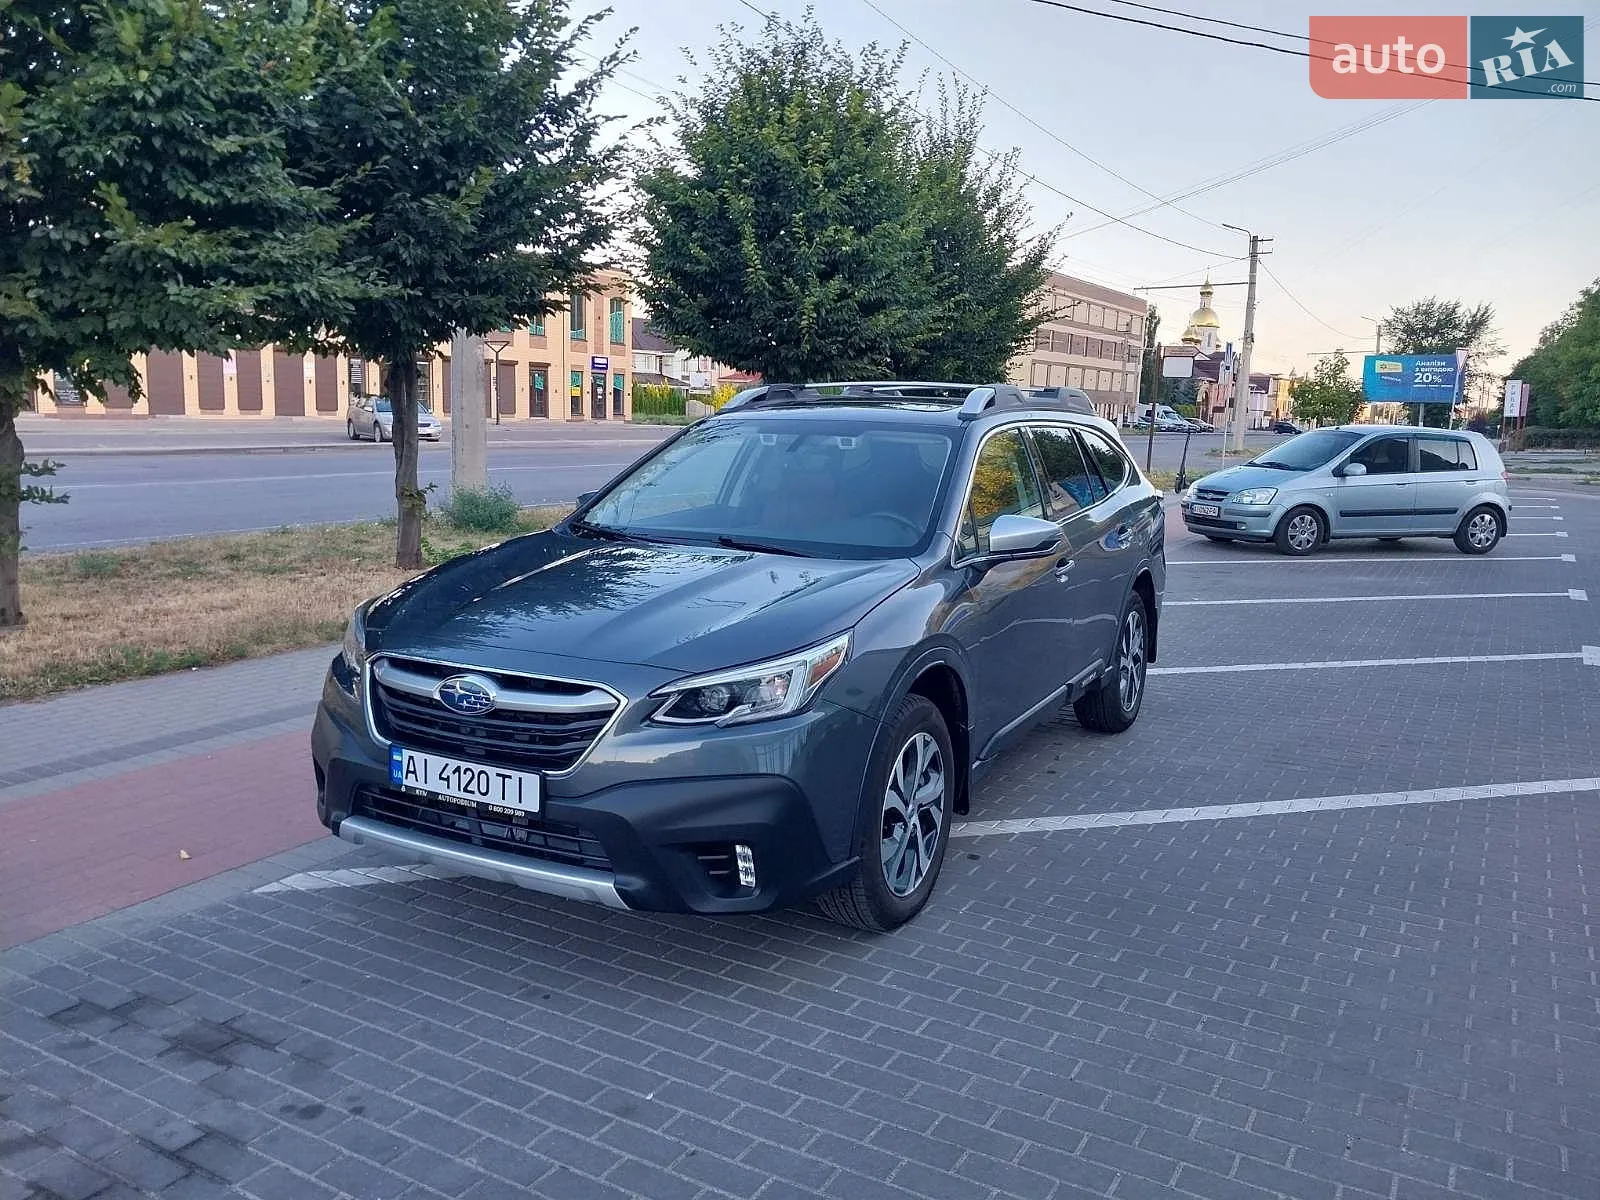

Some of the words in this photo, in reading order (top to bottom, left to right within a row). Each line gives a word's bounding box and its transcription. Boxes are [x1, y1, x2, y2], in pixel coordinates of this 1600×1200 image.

[1414, 372, 1442, 383] 20%
[393, 769, 402, 779] UA
[405, 755, 428, 785] AI
[438, 763, 490, 797] 4120
[496, 773, 523, 804] TI
